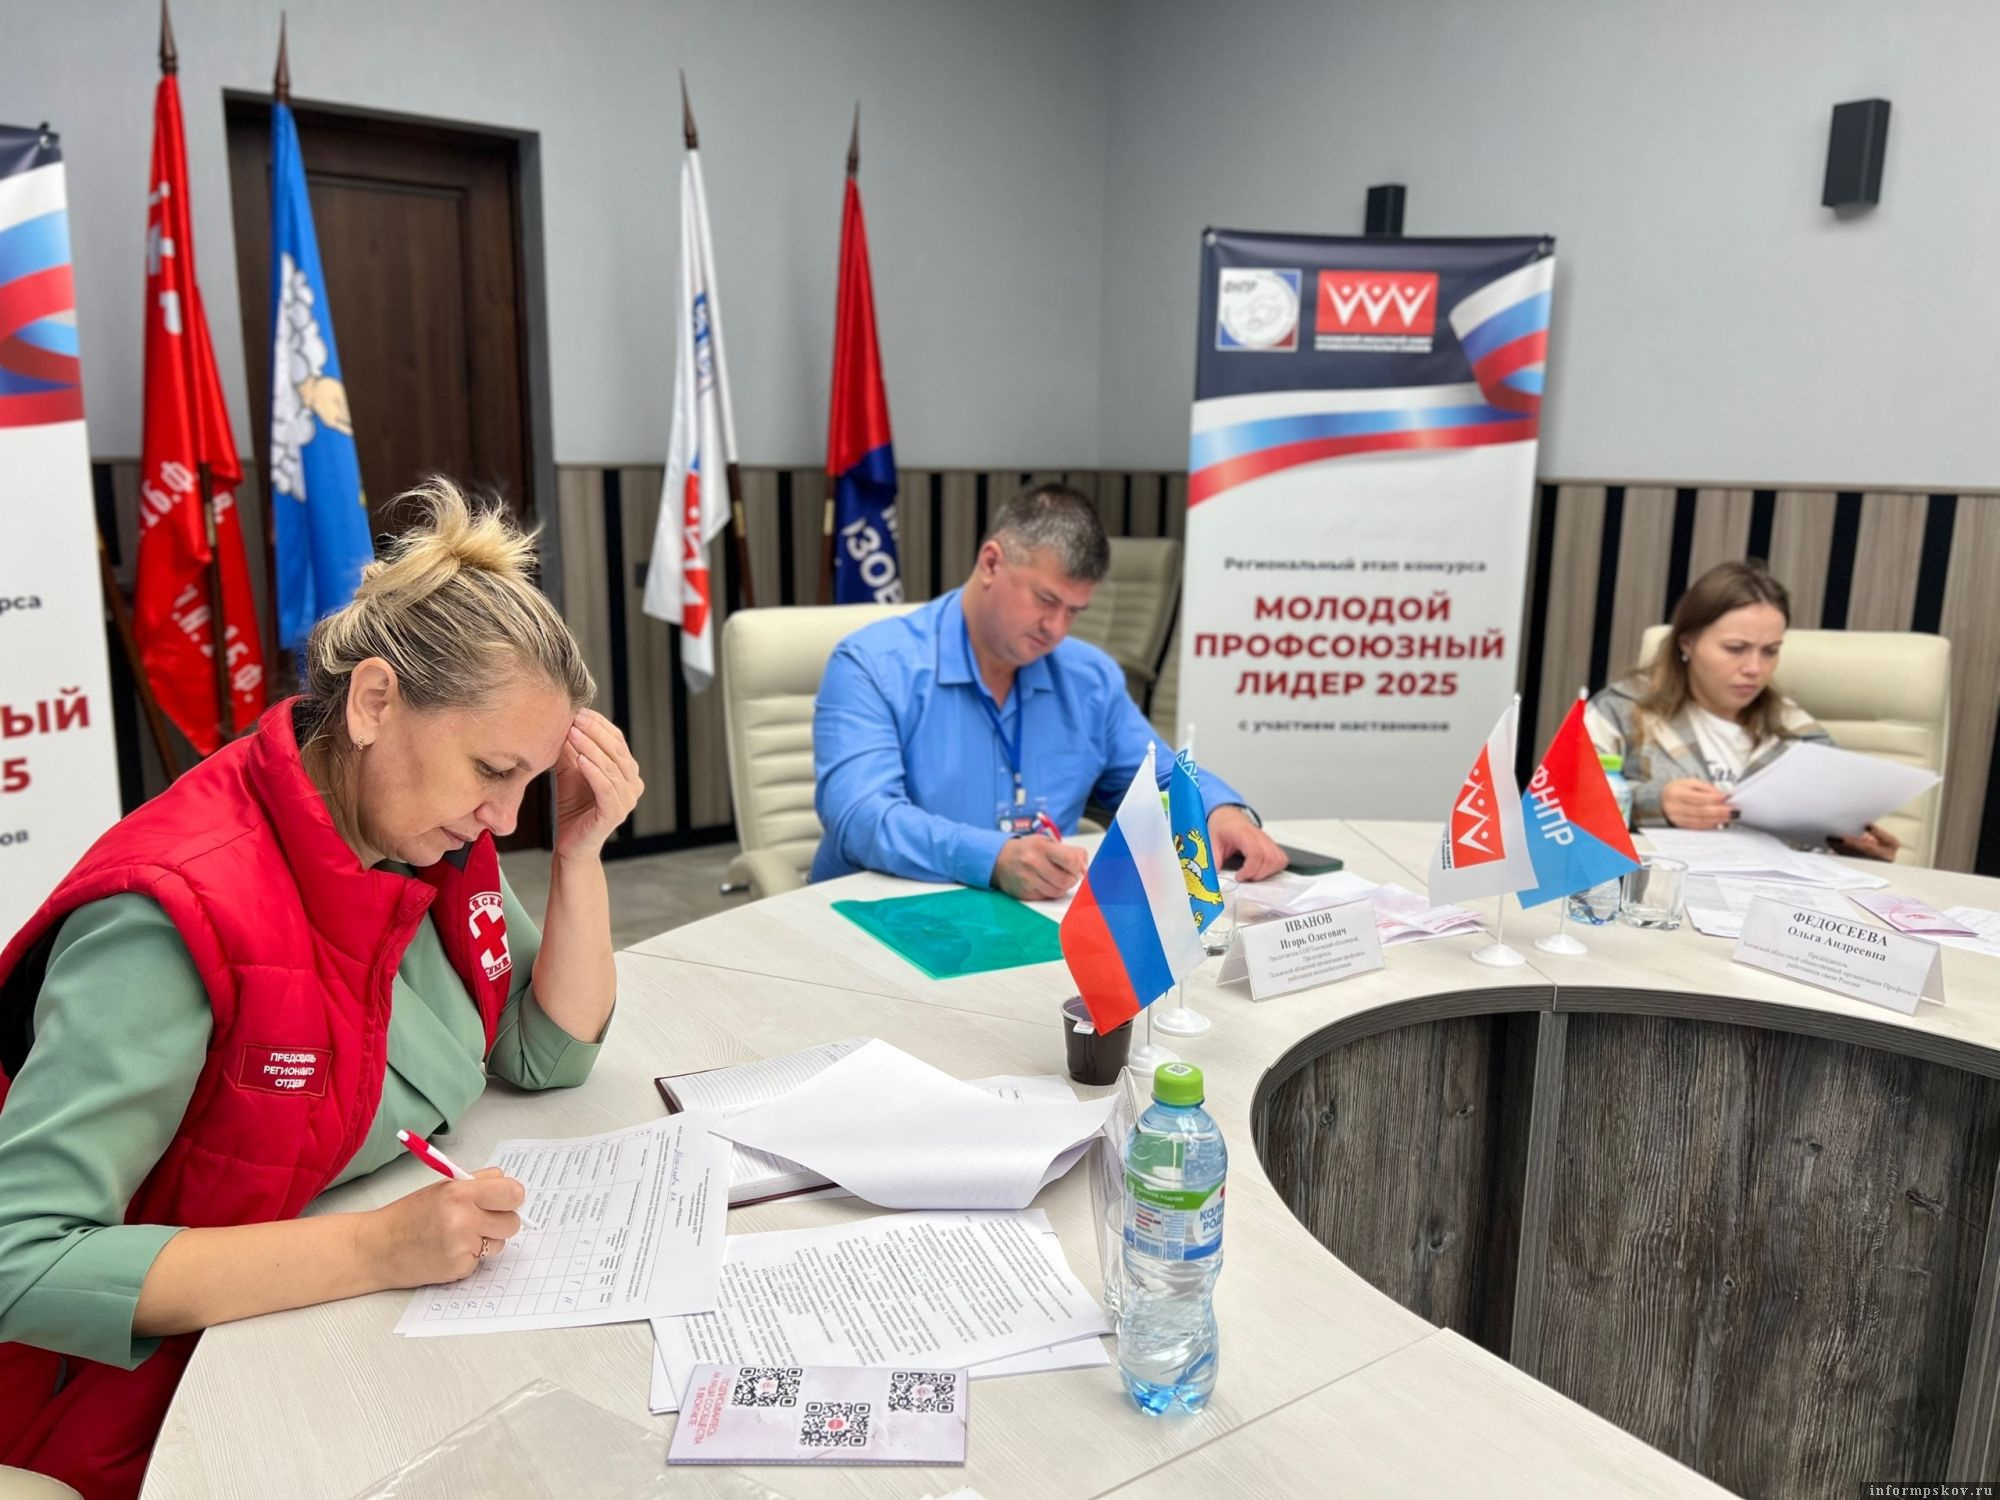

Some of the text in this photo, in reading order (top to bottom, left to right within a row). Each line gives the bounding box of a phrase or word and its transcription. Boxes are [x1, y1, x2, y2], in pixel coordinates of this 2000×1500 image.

[1223, 557, 1487, 574] Региональный этап конкурса
[1254, 589, 1452, 625] МОЛОДОЙ
[1194, 628, 1505, 660] ПРОФСОЮЗНЫЙ
[1236, 671, 1458, 699] ЛИДЕР 2025
[1253, 721, 1335, 734] участием
[1340, 721, 1449, 732] наставников
[1530, 764, 1575, 846] ФНПР
[1284, 912, 1333, 933] ИВАНОВ
[1793, 911, 1888, 947] ФЕДОСЕЕВА
[1280, 928, 1347, 950] Игорь Олегович
[1787, 926, 1887, 962] Ольга Андреевна
